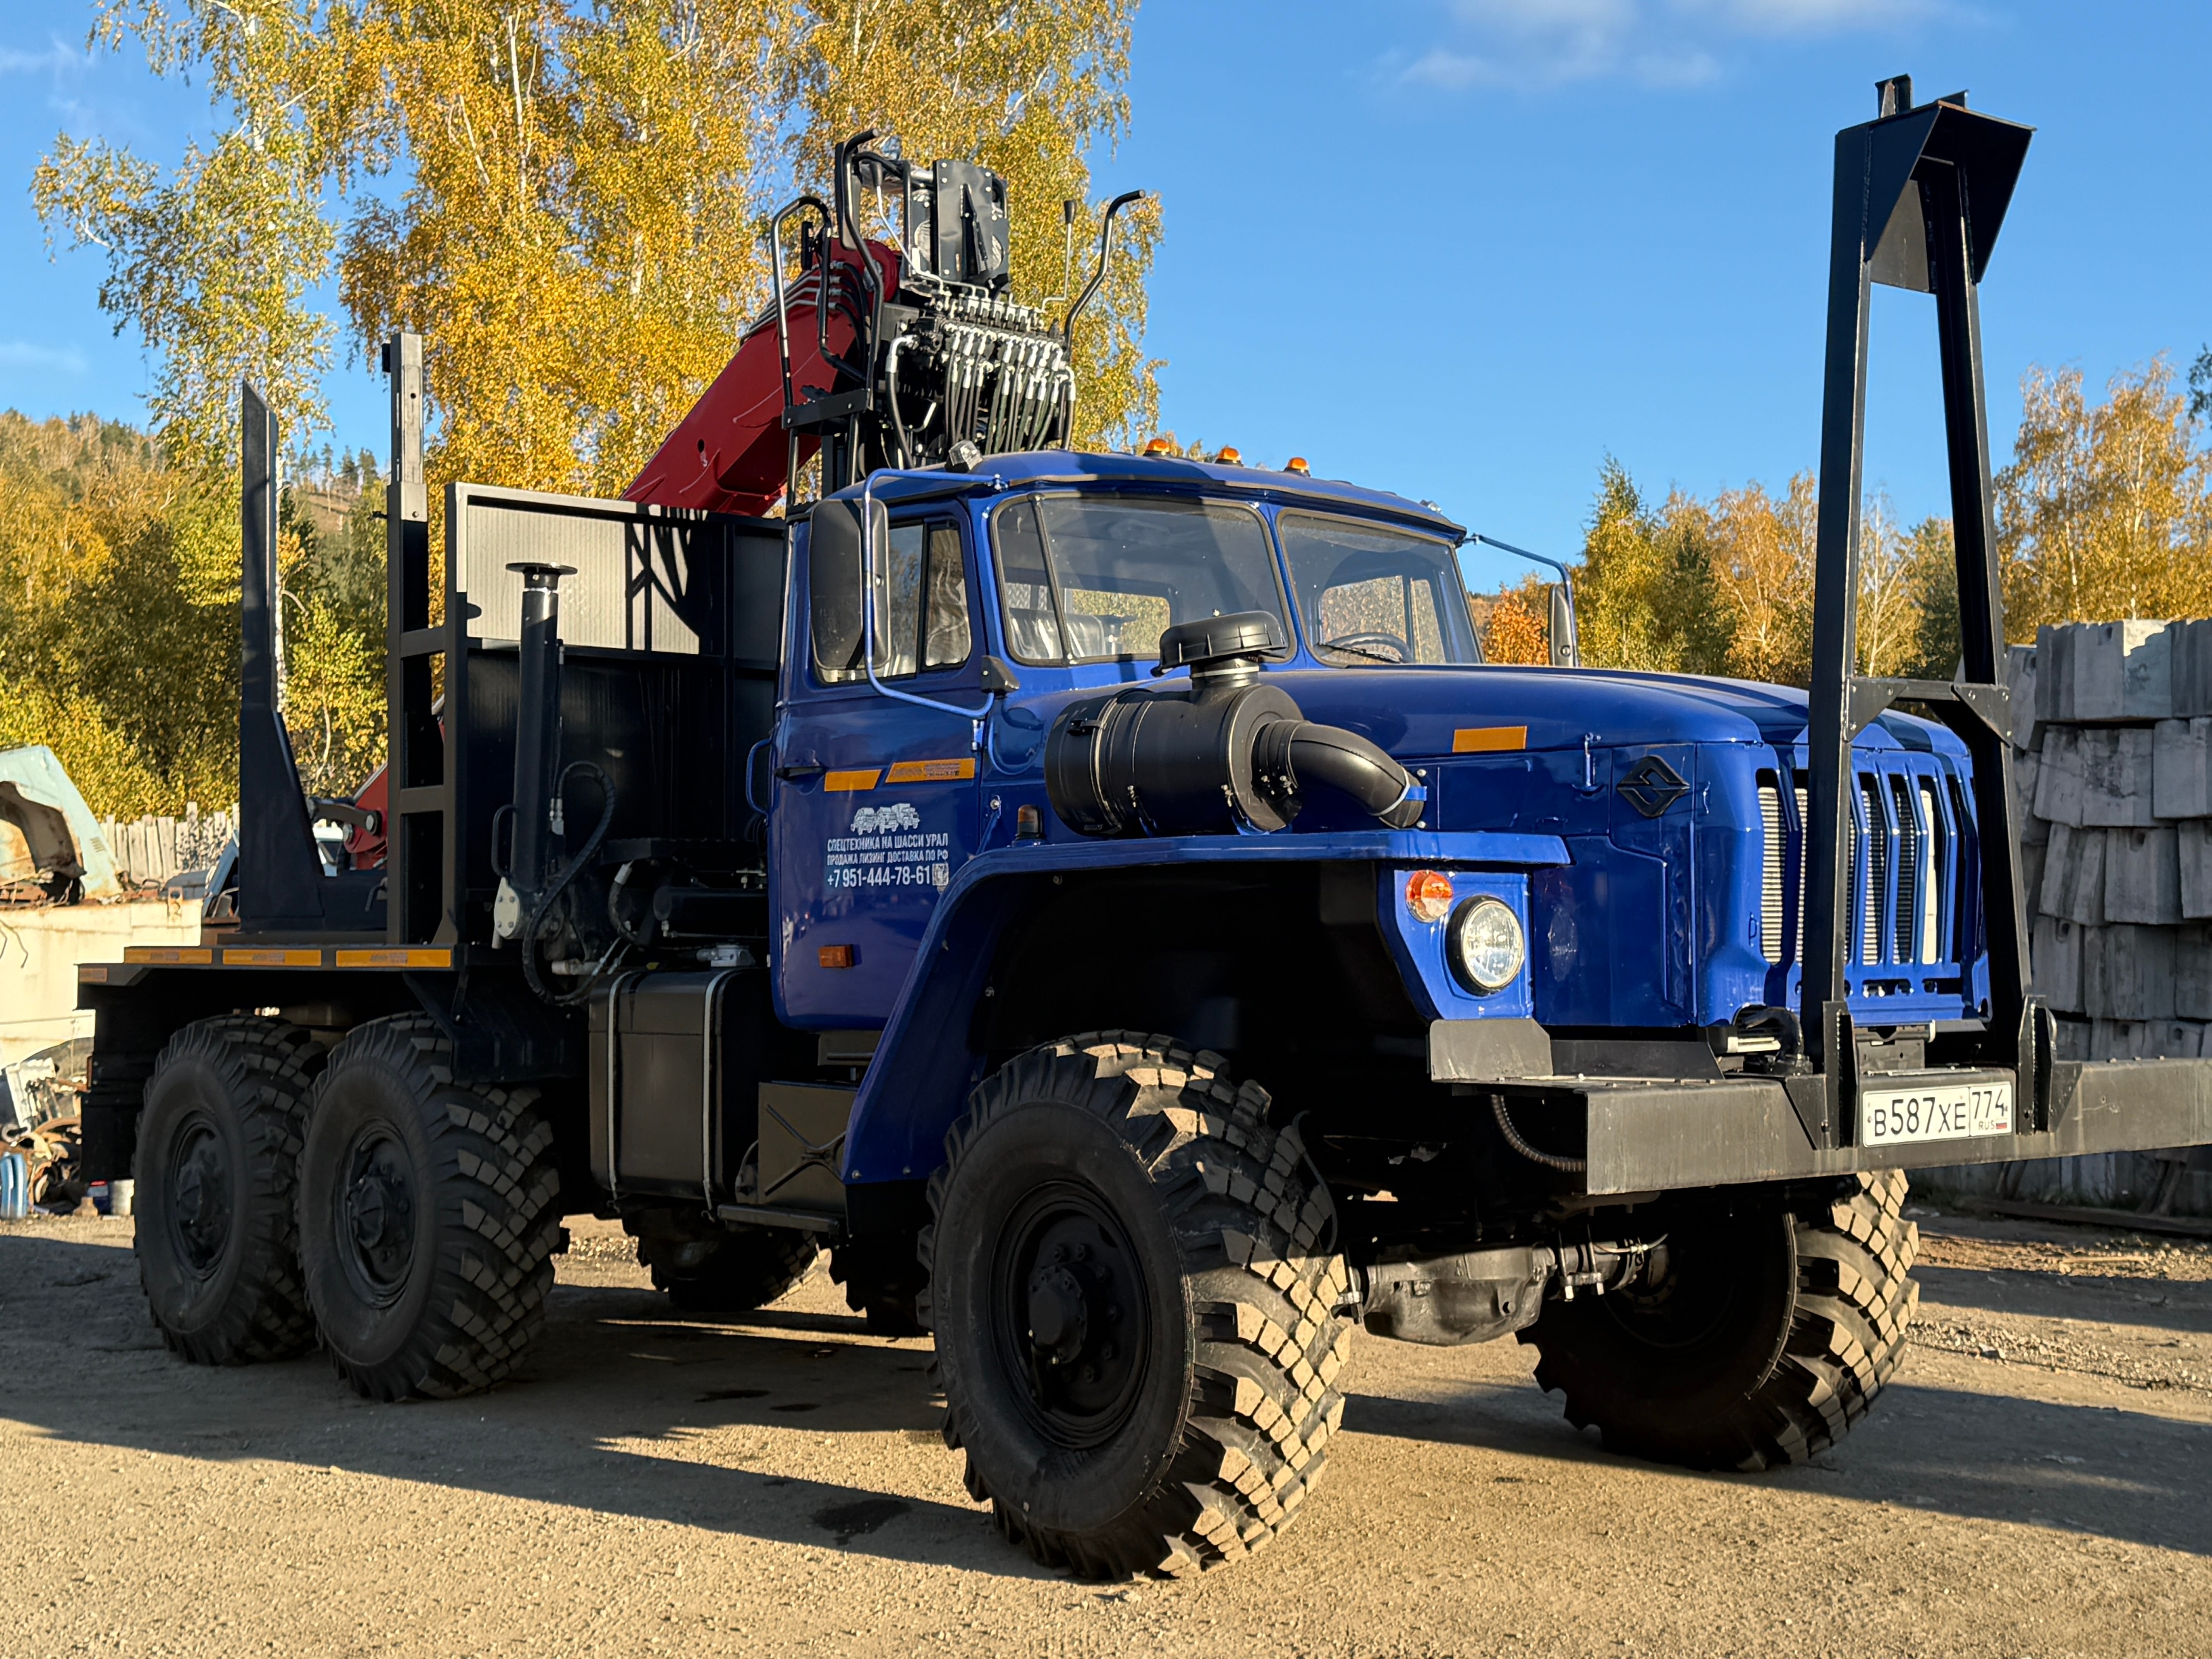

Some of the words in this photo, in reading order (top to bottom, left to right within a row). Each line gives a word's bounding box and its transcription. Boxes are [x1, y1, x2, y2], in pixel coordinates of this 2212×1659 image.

[827, 837, 880, 852] СПЕЦТЕХНИКА
[882, 836, 893, 849] НА
[895, 834, 924, 848] ШАССИ
[926, 833, 948, 847] УРАЛ
[827, 853, 858, 866] ПРОДАЖА
[887, 850, 924, 864] ДОСТАВКА
[925, 849, 936, 861] ПО
[937, 849, 948, 860] РФ
[1972, 1089, 2004, 1120] 774
[1978, 1120, 1995, 1130] RUS
